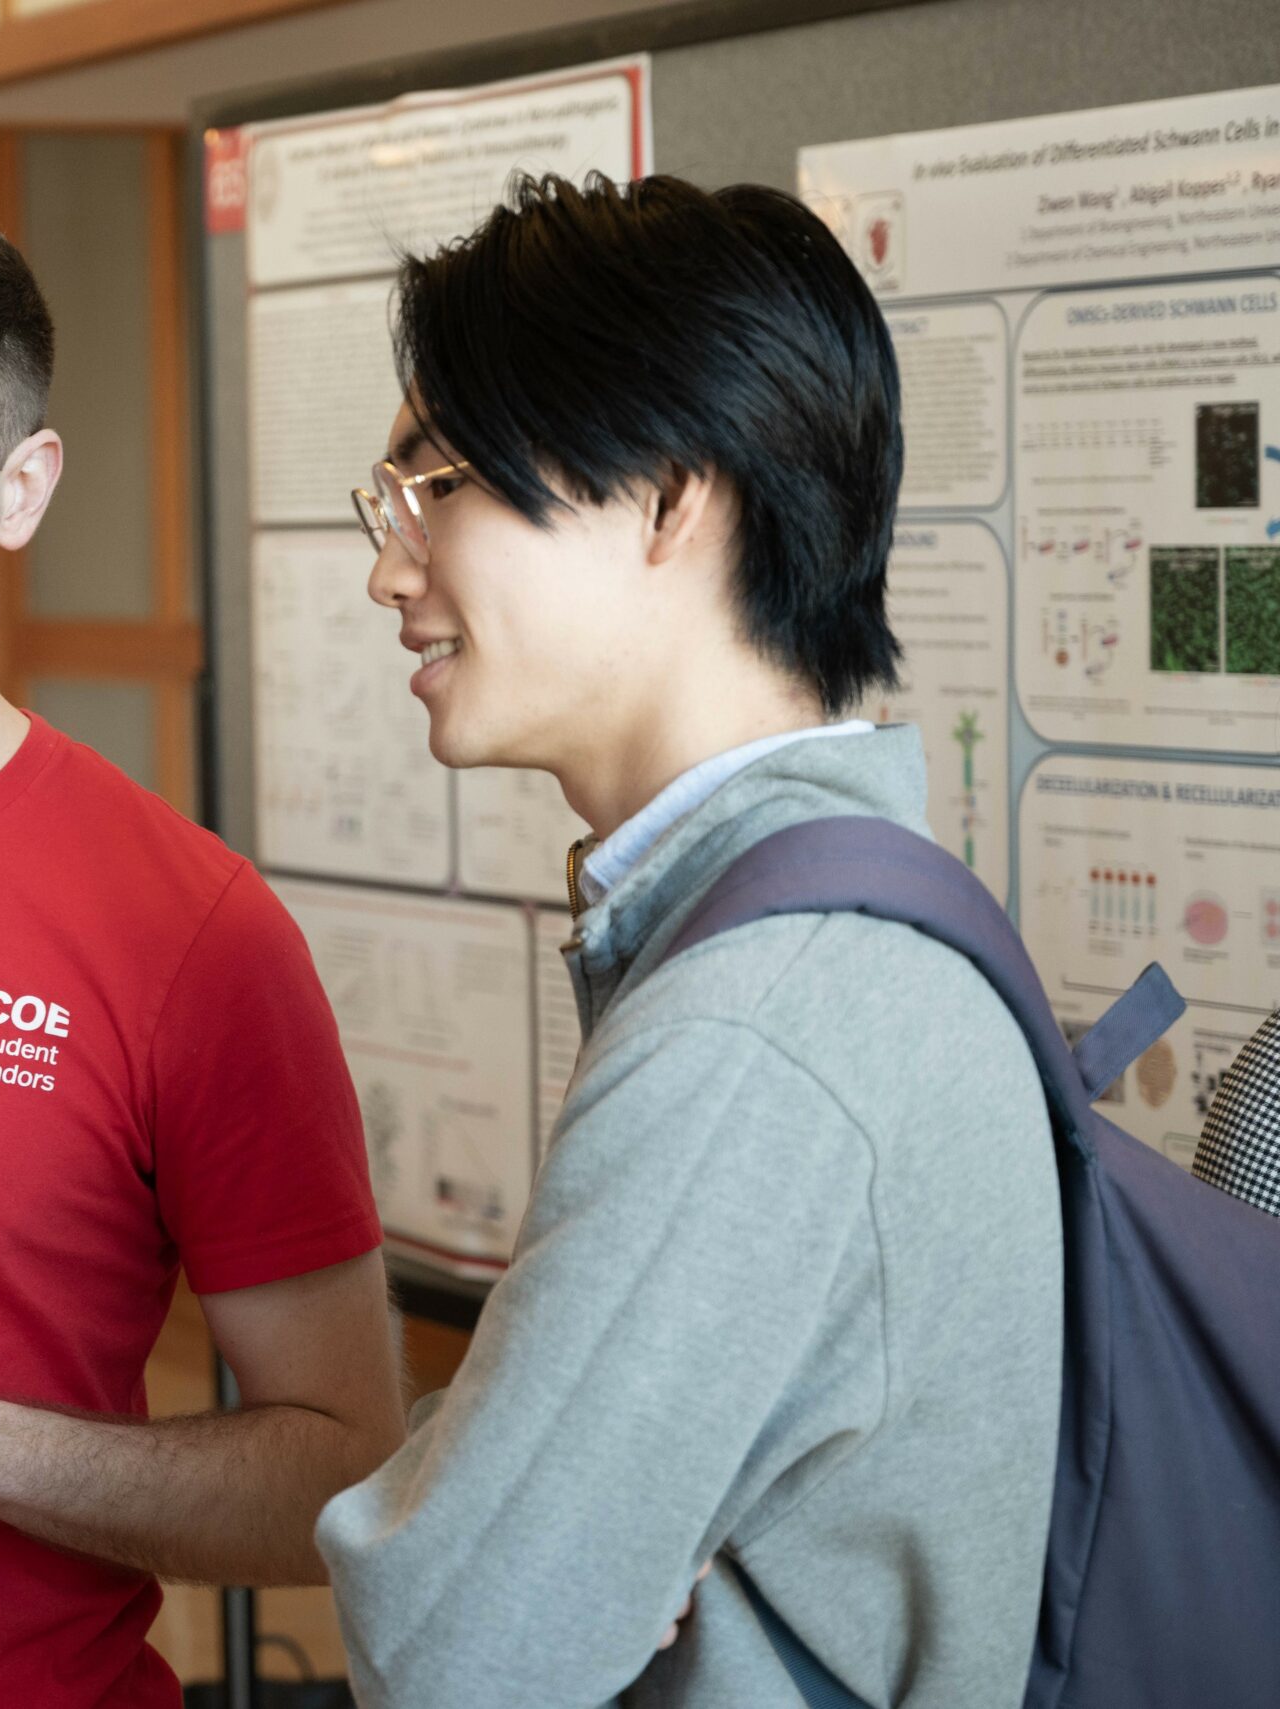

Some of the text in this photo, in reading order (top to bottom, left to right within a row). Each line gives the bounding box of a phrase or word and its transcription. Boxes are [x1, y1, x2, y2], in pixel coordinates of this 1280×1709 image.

[1153, 128, 1221, 151] Schwann
[1224, 117, 1261, 143] Cells
[1240, 292, 1277, 313] CELLS
